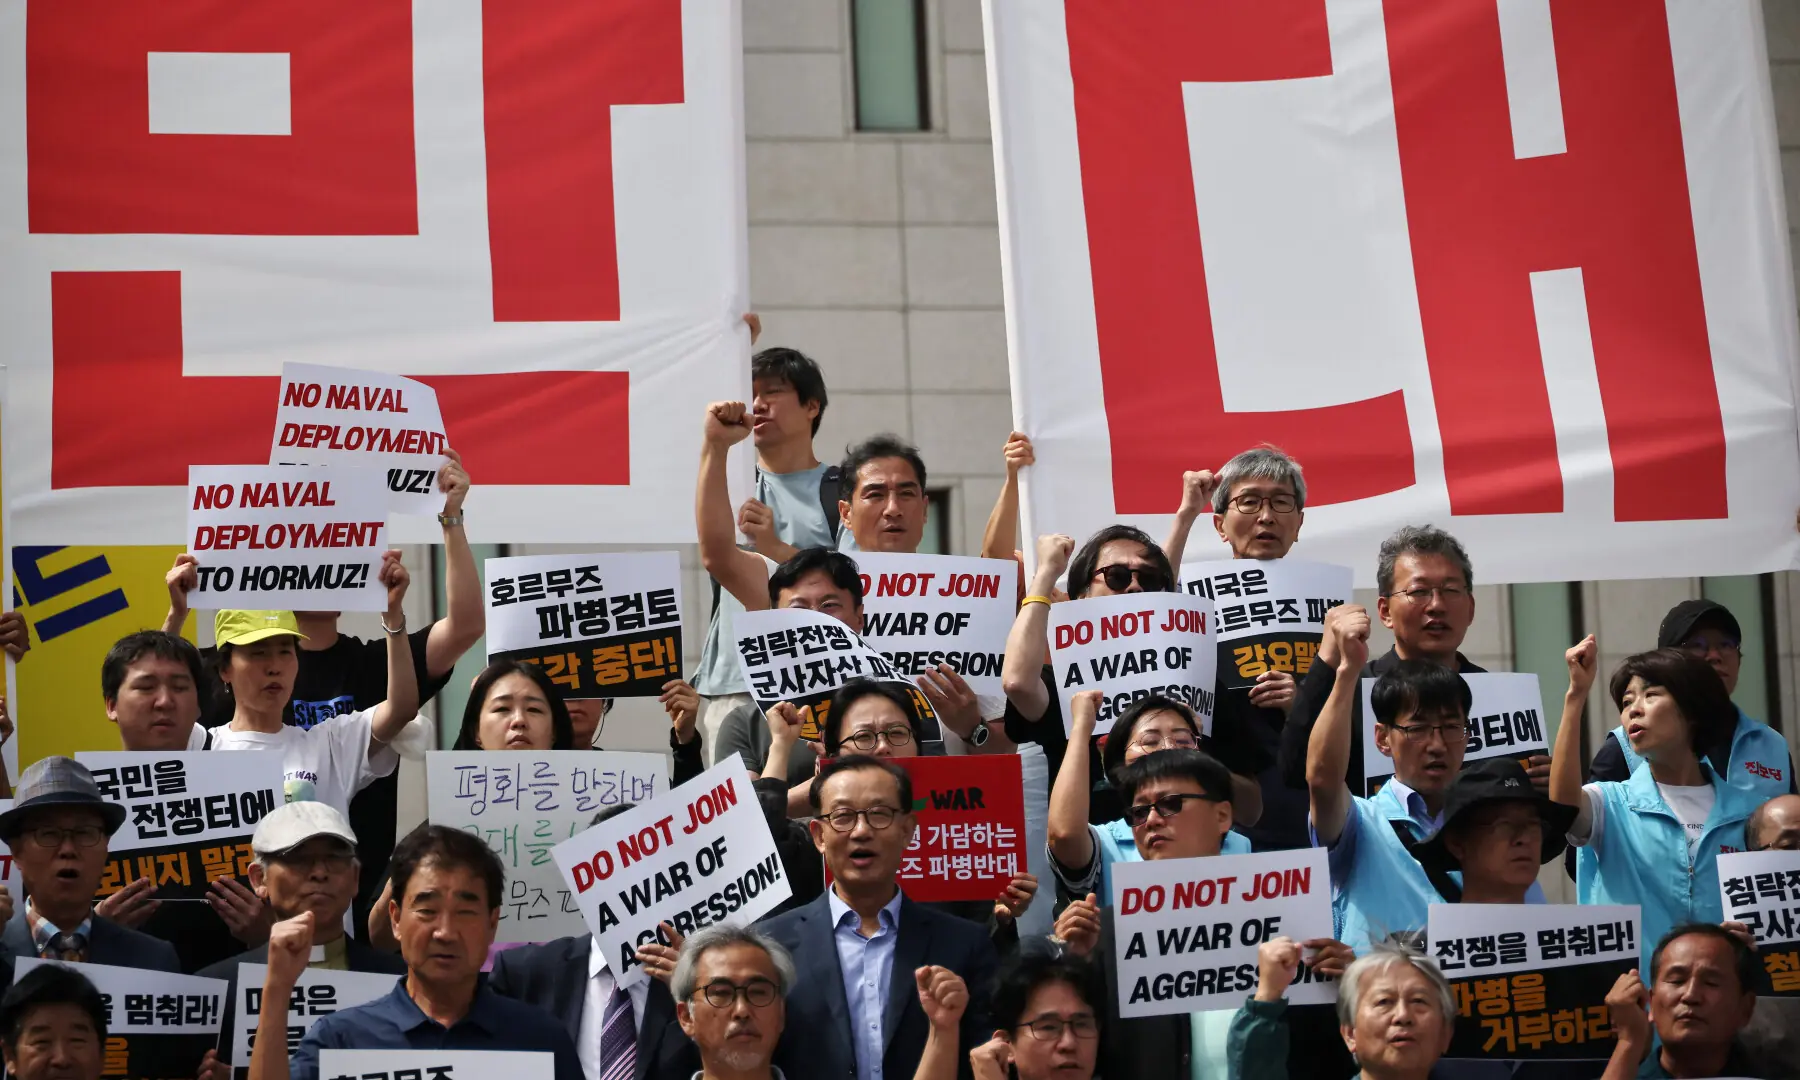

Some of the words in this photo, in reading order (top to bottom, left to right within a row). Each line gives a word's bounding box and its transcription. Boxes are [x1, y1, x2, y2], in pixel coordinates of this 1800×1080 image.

[283, 382, 321, 408] NO
[325, 384, 408, 413] NAVAL
[279, 423, 445, 455] DEPLOYMENT
[193, 484, 234, 510] NO
[239, 481, 336, 508] NAVAL
[194, 522, 384, 550] DEPLOYMENT
[197, 566, 234, 592] TO
[239, 563, 370, 591] HORMUZ!
[490, 565, 603, 607] 호르무즈
[859, 574, 872, 597] O
[877, 573, 935, 598] NOT
[938, 573, 1000, 598] JOIN
[1187, 569, 1268, 601] 미국은
[536, 588, 680, 640] 파병검토
[863, 612, 929, 637] WAR
[934, 612, 970, 637] OF
[1055, 620, 1094, 650] DO
[1100, 609, 1154, 641] NOT
[1160, 608, 1206, 635] JOIN
[1305, 598, 1344, 625] 파
[592, 636, 678, 686] 중단!
[738, 625, 853, 667] 침략전쟁
[1233, 641, 1321, 678] 강요말
[750, 655, 862, 699] 군사자산
[1064, 662, 1084, 688] A
[1090, 648, 1158, 681] WAR
[1164, 646, 1192, 670] OF
[1465, 709, 1543, 754] 터에
[90, 759, 187, 800] 국민을
[454, 761, 560, 816] 평화를
[571, 767, 655, 812] 말하며
[930, 786, 986, 811] WAR
[131, 789, 275, 840] 전쟁터에
[571, 850, 614, 894] DO
[617, 815, 674, 869] NOT
[682, 777, 738, 835] JOIN
[928, 822, 1017, 850] 가담하는
[598, 901, 620, 934] A
[618, 861, 693, 917] WAR
[695, 835, 728, 877] OF
[929, 852, 1018, 881] 파병반대
[497, 880, 551, 921] 무즈
[1120, 885, 1166, 916] DO
[1172, 876, 1237, 910] NOT
[1242, 866, 1311, 902] JOIN
[1124, 932, 1148, 960] A
[1156, 922, 1233, 956] WAR
[1240, 916, 1281, 947] OF
[1734, 907, 1800, 941] 군사
[1435, 931, 1528, 971] 전쟁을
[1537, 920, 1635, 961] 멈춰라!
[124, 994, 219, 1027] 멈춰라!
